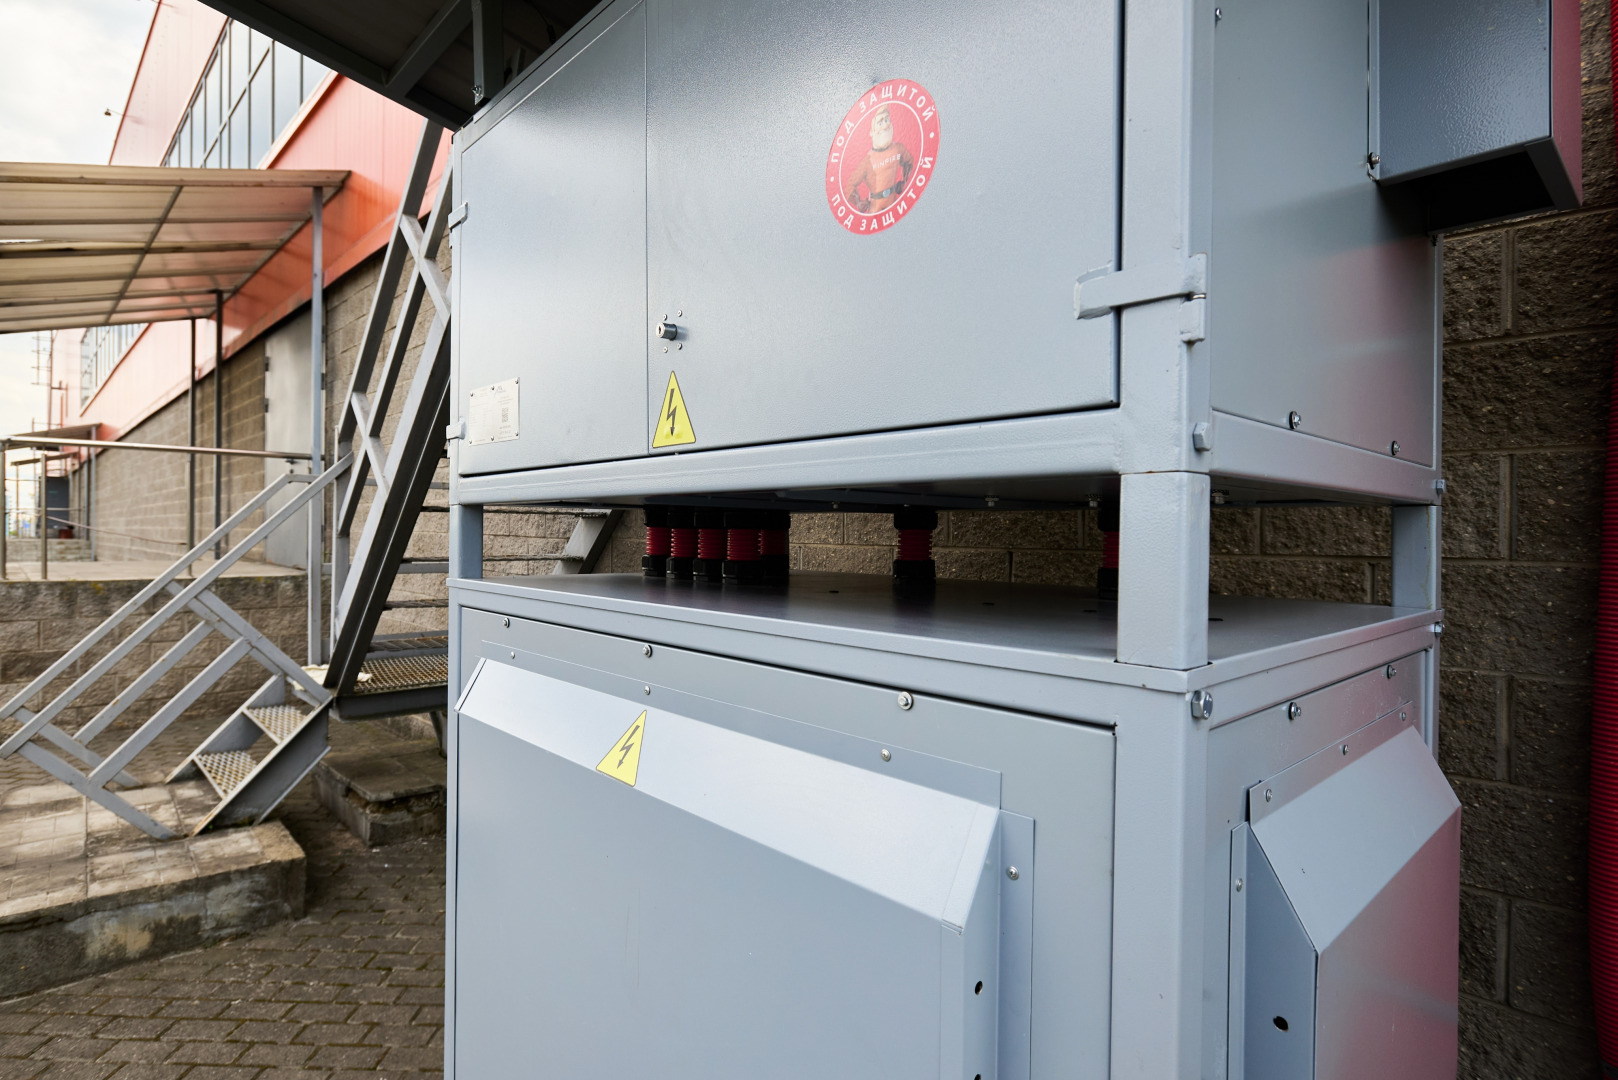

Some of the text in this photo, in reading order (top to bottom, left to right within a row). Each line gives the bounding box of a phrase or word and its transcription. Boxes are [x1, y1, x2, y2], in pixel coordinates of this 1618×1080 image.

[831, 84, 936, 163] ПОД ЗАЩИТОЙ
[831, 156, 934, 231] ПОД ЗАЩИТОЙ
